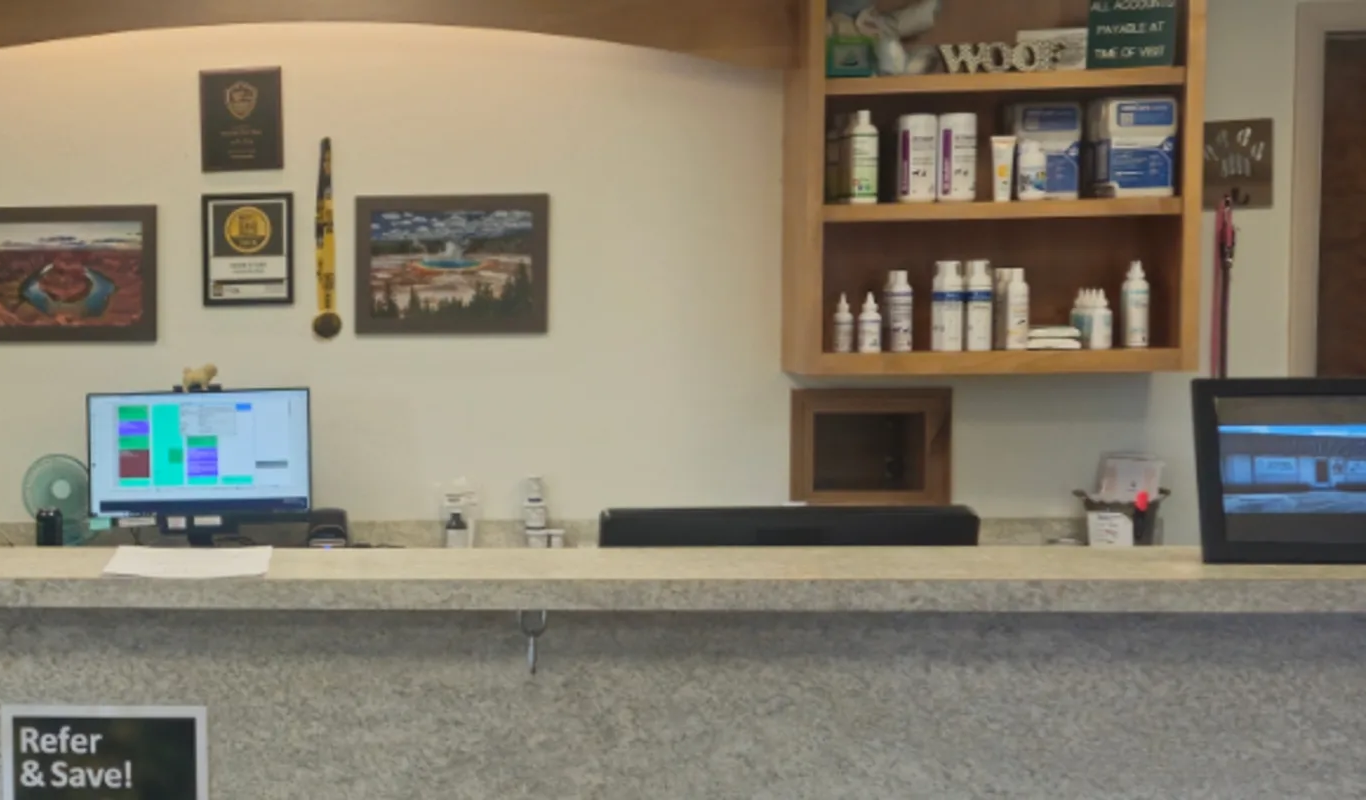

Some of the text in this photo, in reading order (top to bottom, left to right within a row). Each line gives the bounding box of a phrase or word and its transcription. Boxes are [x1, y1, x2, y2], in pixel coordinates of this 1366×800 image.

[1149, 21, 1165, 32] AT
[939, 41, 1066, 74] WOOF
[20, 726, 102, 754] Refer
[20, 760, 132, 788] & Save!
